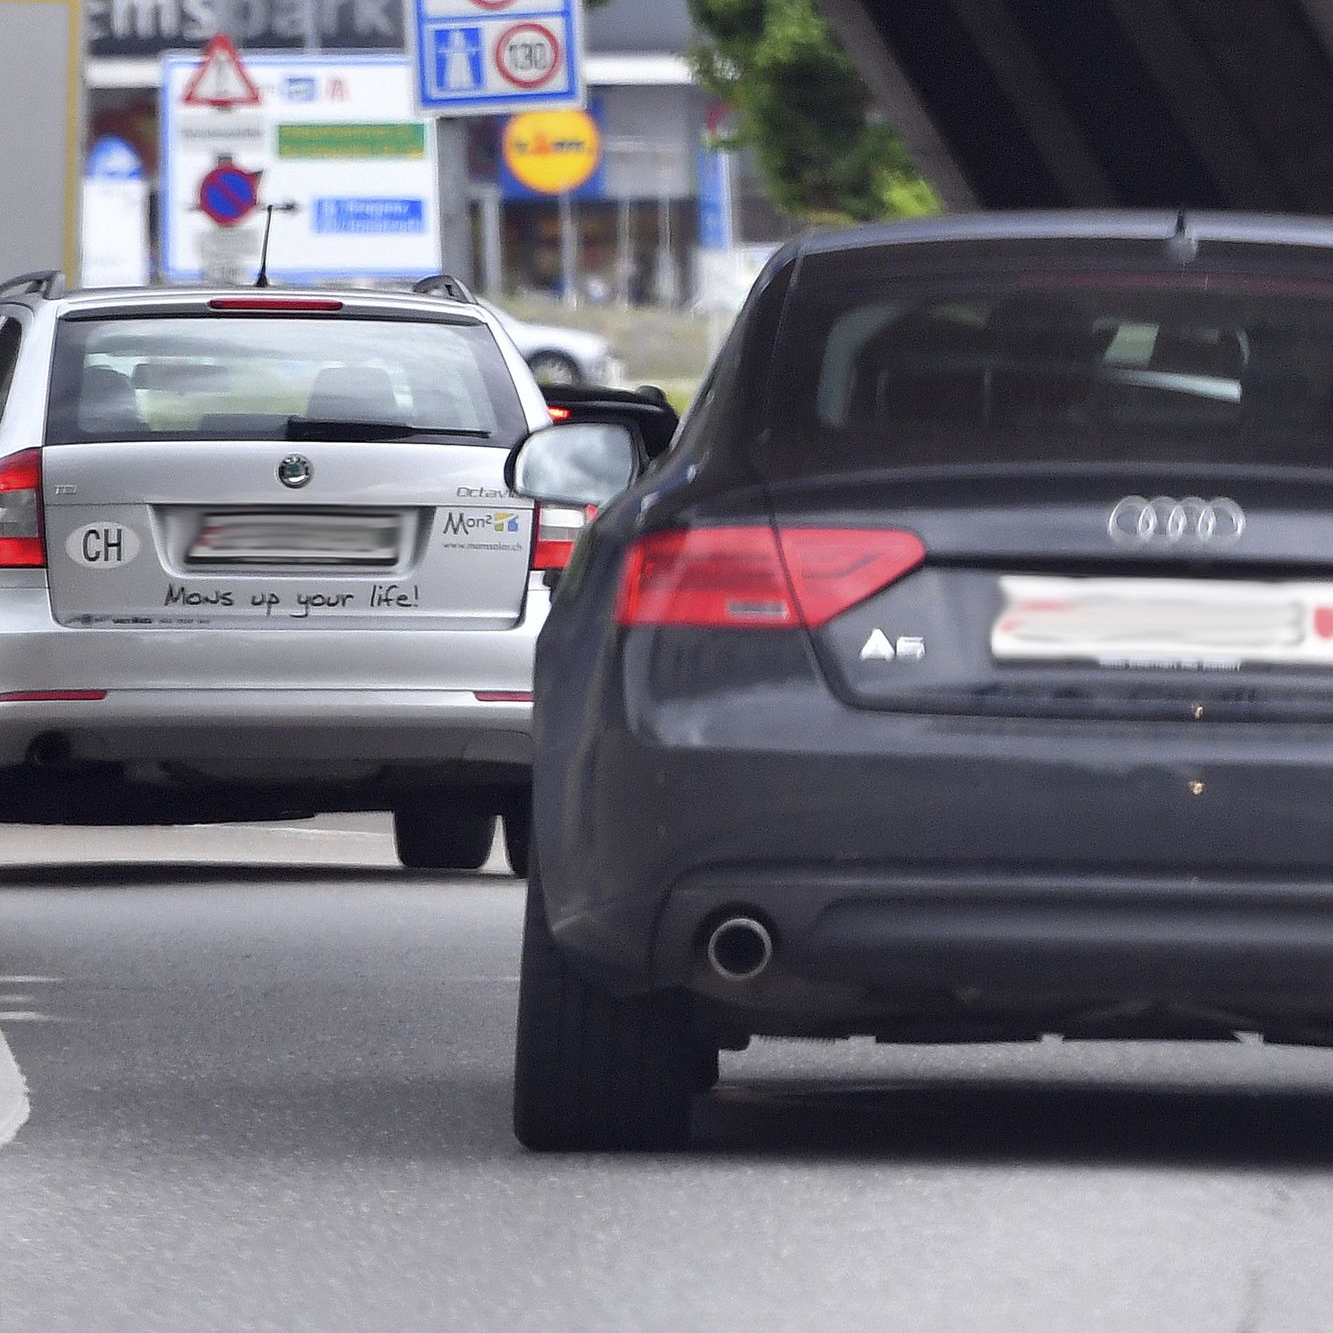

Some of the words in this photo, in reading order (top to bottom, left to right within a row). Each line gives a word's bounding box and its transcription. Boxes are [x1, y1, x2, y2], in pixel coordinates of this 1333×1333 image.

[82, 529, 122, 562] CH
[251, 592, 280, 615] up
[289, 592, 354, 618] your
[370, 585, 419, 607] life!
